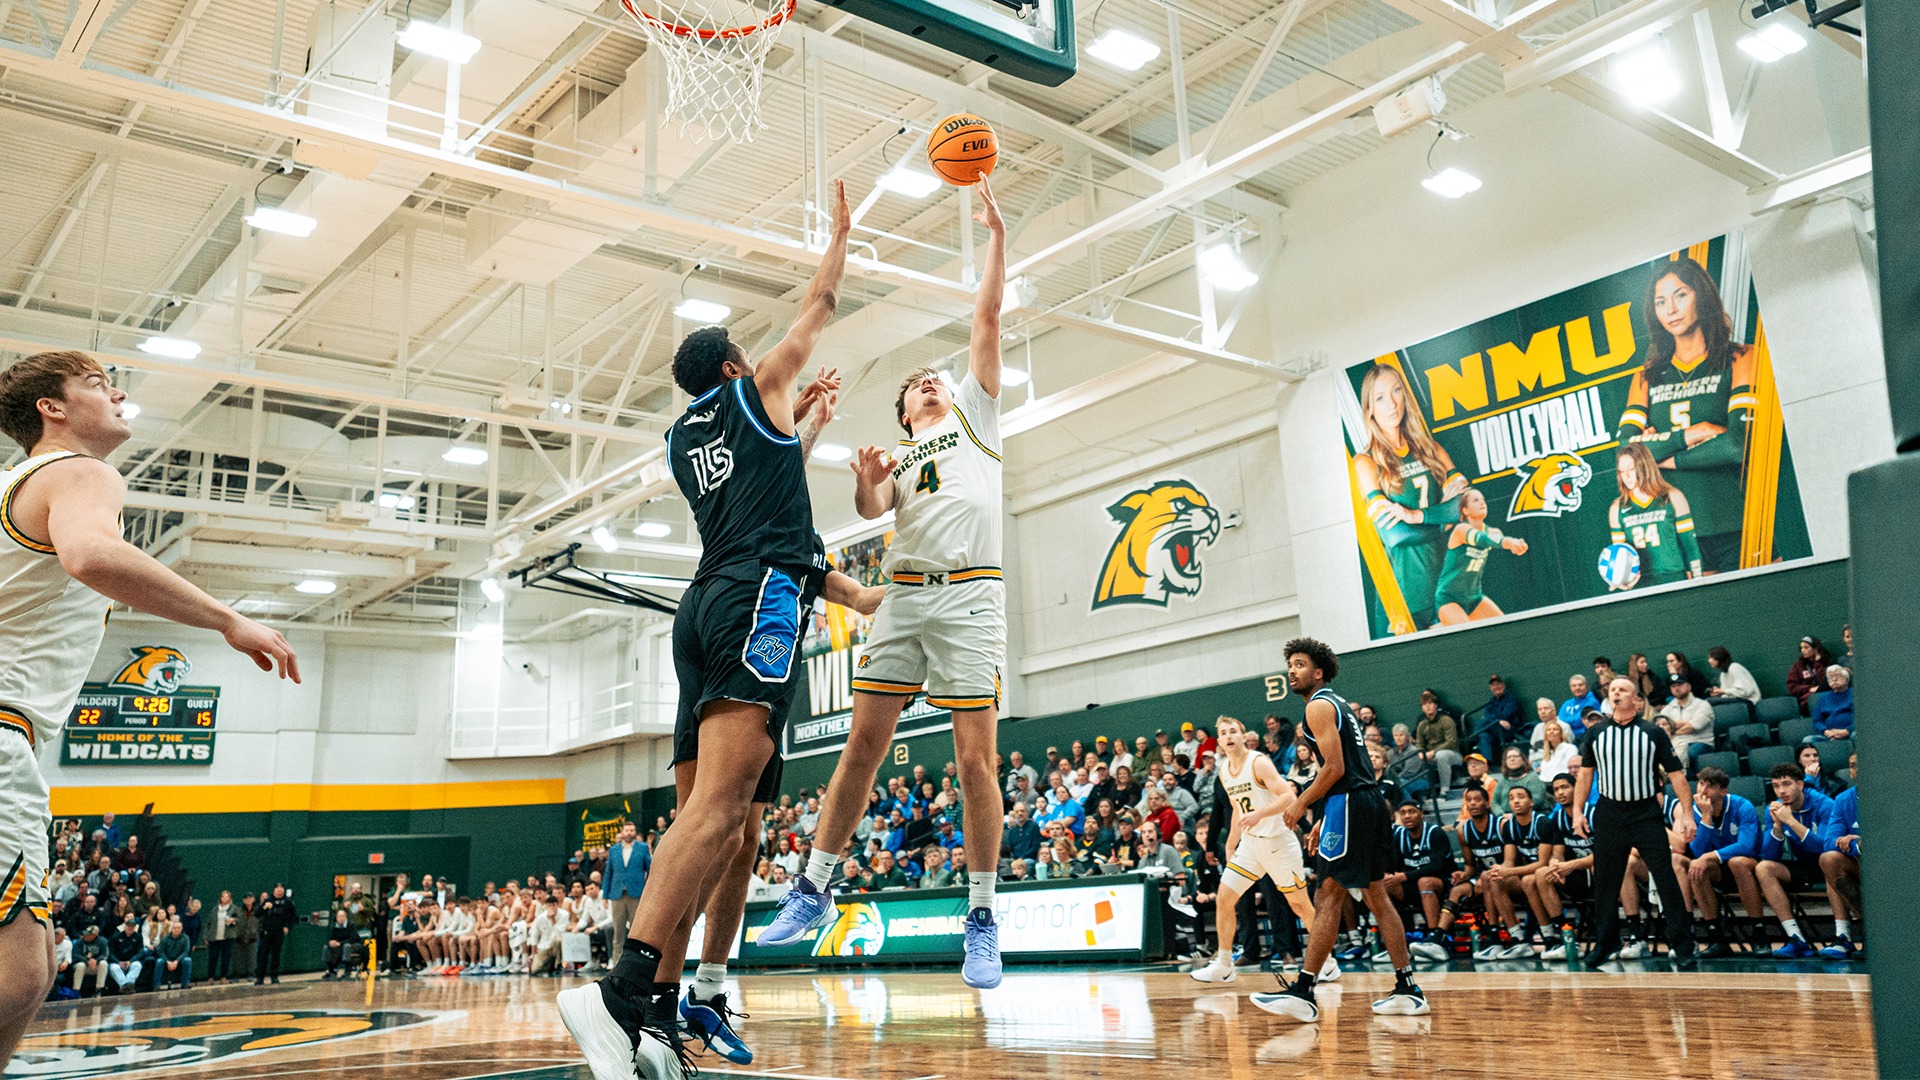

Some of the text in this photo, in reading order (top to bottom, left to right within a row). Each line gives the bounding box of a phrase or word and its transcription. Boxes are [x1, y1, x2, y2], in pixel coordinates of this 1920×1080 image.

[943, 117, 990, 133] Wilson
[962, 138, 988, 152] EVO
[1424, 301, 1636, 421] NMU
[1649, 375, 1721, 396] NORTHERN
[1651, 384, 1718, 404] MICHIGAN
[1670, 400, 1690, 432] 5
[1470, 386, 1611, 475] VOLLEYBALL
[686, 431, 734, 497] 15
[915, 458, 942, 494] 4
[1412, 475, 1428, 509] 7
[1631, 523, 1660, 549] 24
[928, 574, 943, 585] N
[1265, 675, 1288, 701] 3
[133, 697, 169, 713] 9:26
[187, 700, 214, 709] GUEST
[78, 709, 101, 725] 22
[197, 712, 212, 726] 15
[97, 733, 183, 742] HOME OF THE
[796, 716, 852, 740] NORTHER
[69, 744, 210, 760] WILDCATS
[894, 744, 909, 765] 2
[1236, 797, 1254, 814] 12
[996, 896, 1080, 929] Honor
